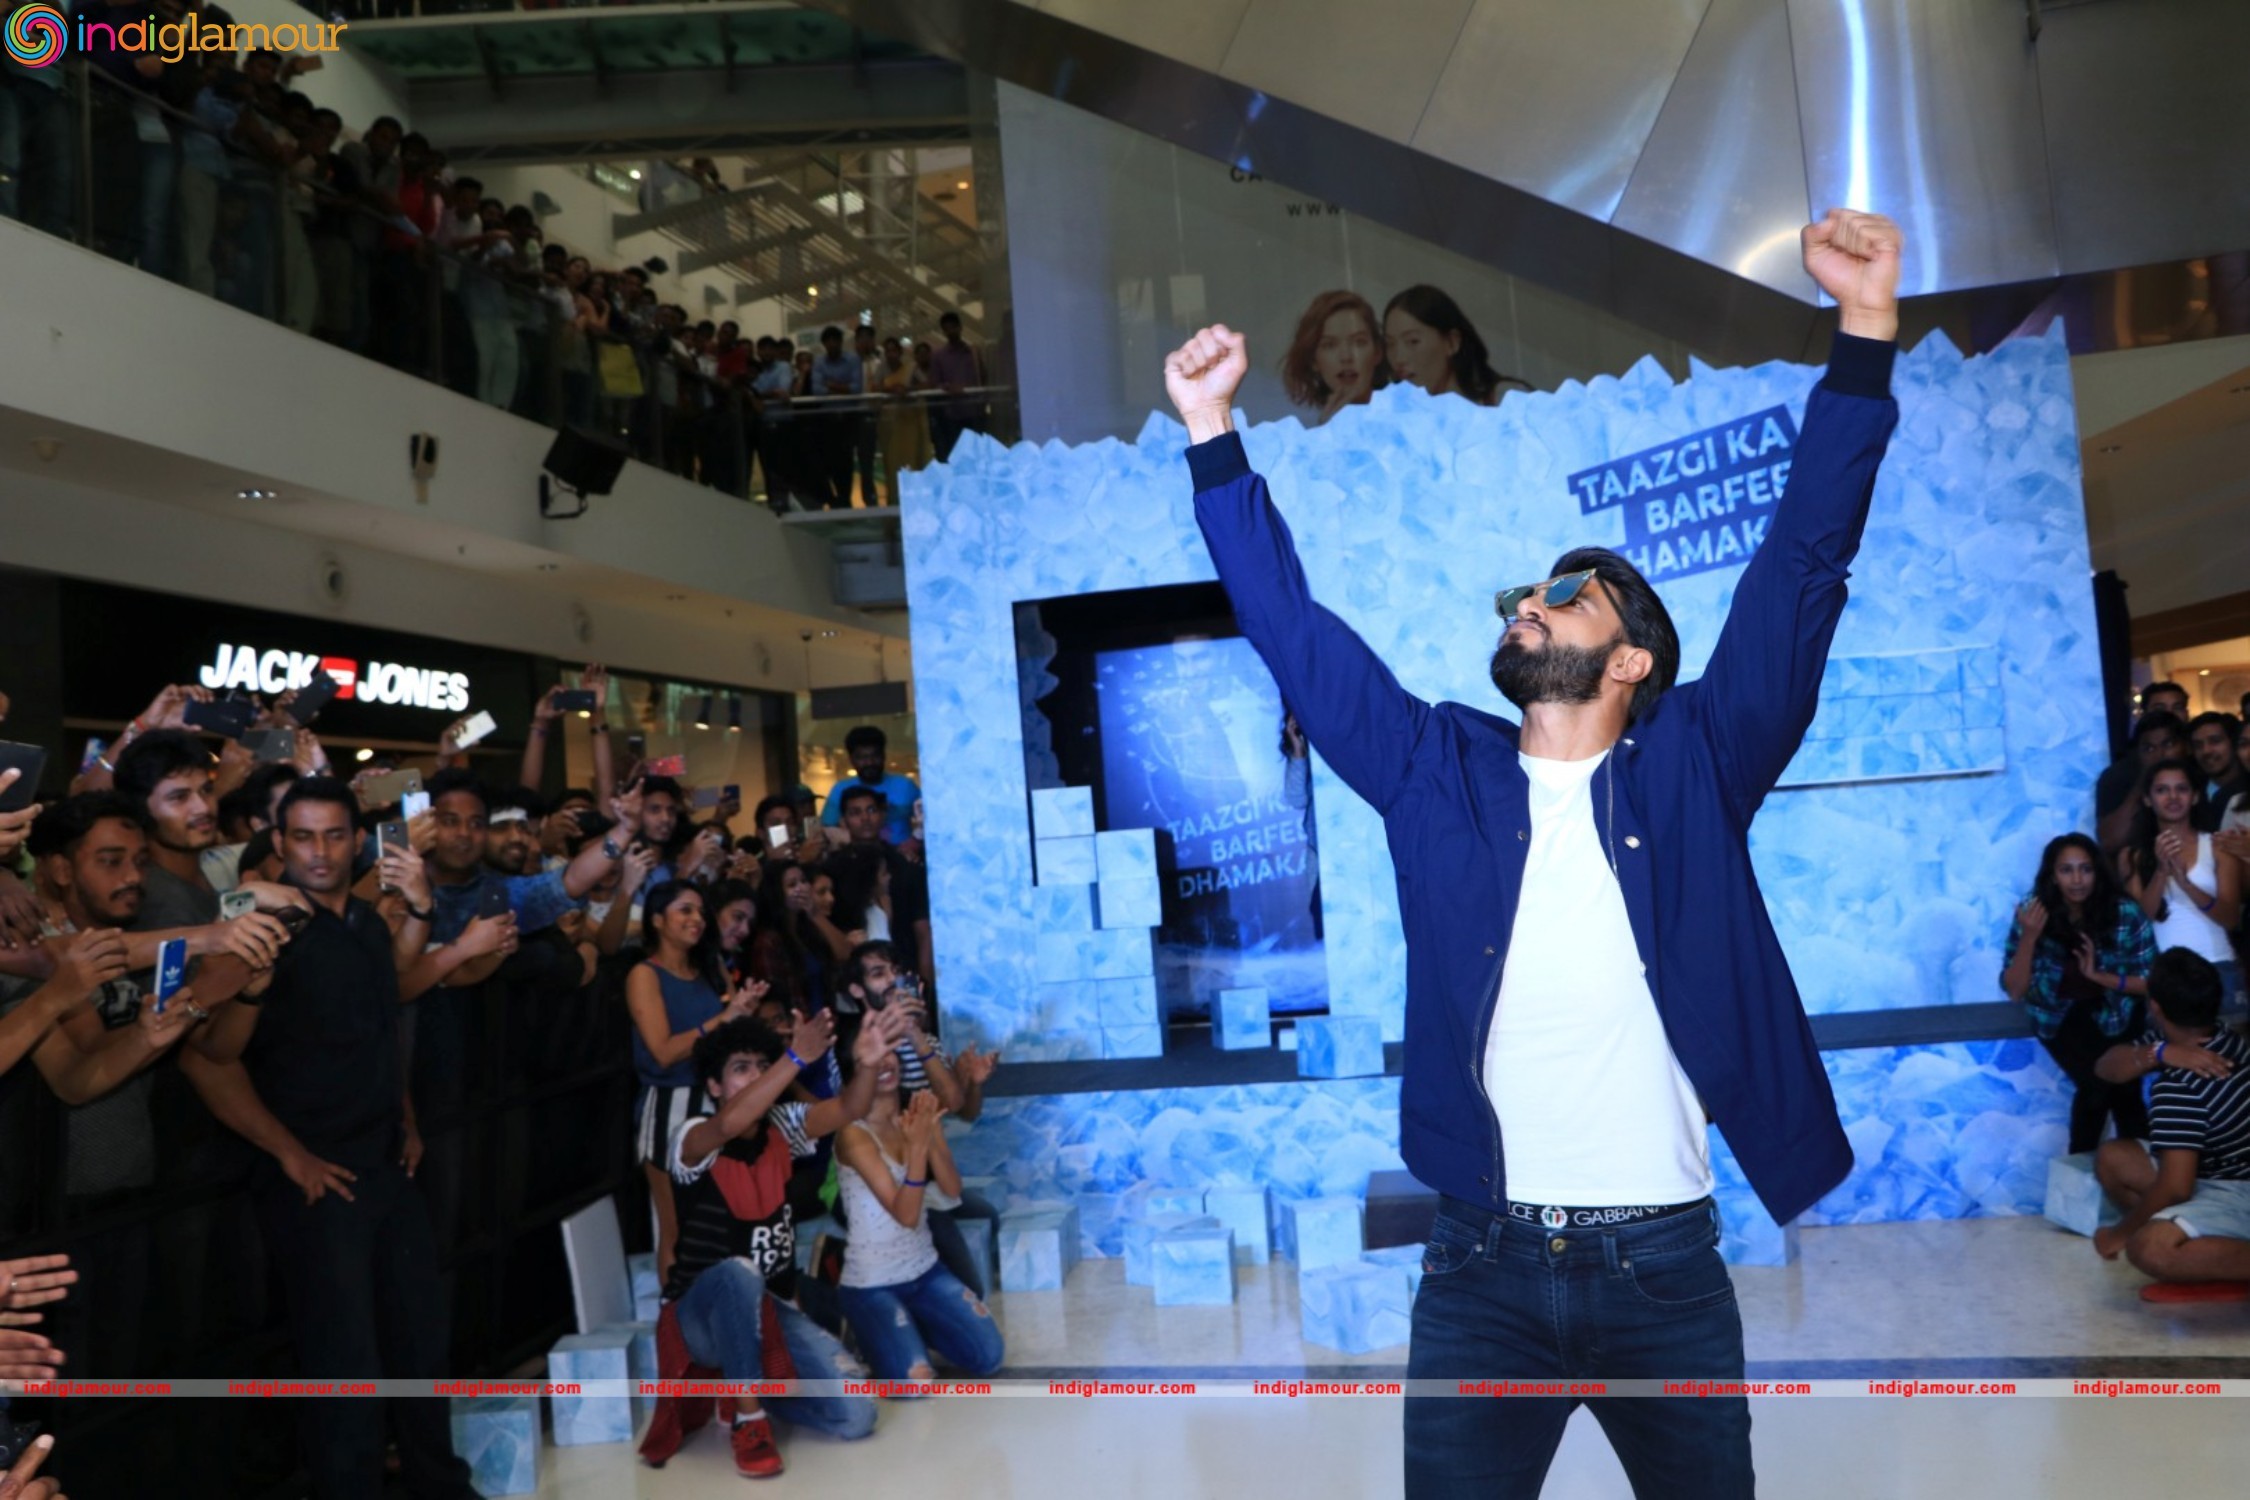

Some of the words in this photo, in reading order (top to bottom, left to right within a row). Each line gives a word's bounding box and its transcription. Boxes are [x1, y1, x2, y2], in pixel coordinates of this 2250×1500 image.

[1578, 437, 1719, 507] TAAZGI
[1725, 417, 1790, 464] KA
[200, 643, 319, 694] JACK
[356, 661, 469, 712] JONES
[1166, 797, 1262, 843] TAAZGI
